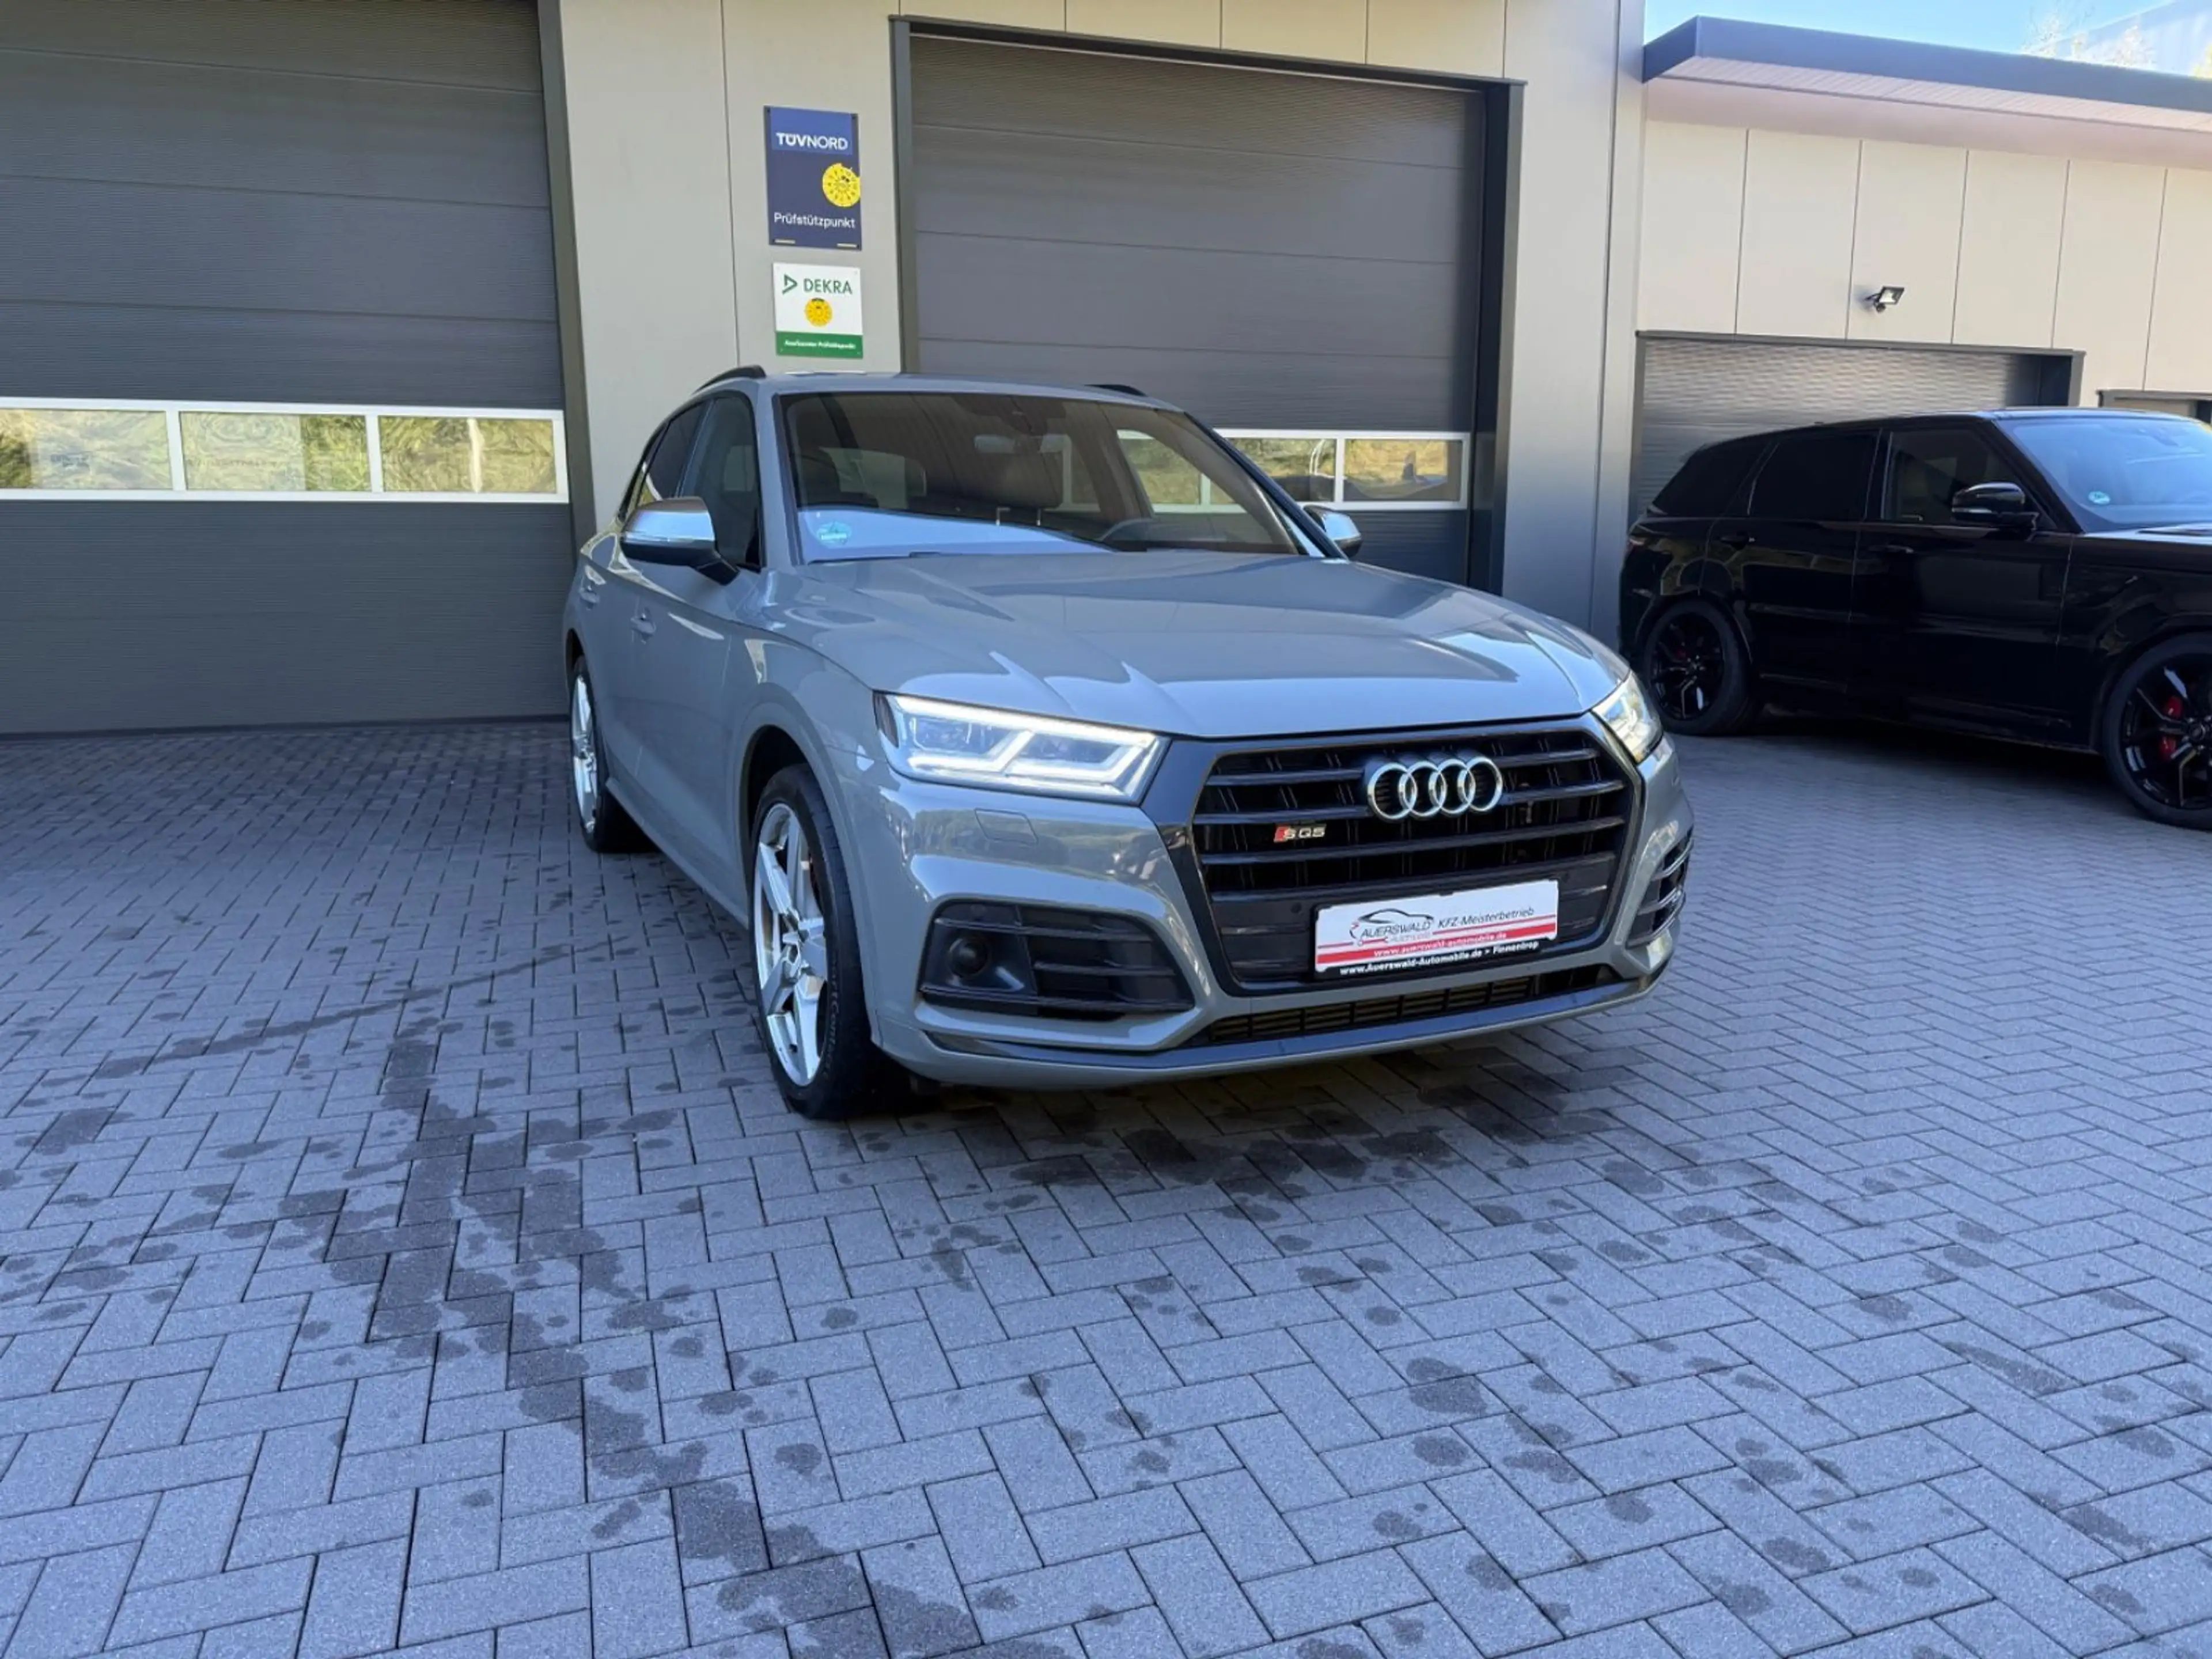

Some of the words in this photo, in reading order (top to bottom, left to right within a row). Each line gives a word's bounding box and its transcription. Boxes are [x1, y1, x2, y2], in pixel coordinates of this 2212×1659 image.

[774, 211, 855, 229] Prüfstützpunkt
[804, 278, 853, 295] DEKRA
[1360, 921, 1431, 938] AUERSWALD
[1438, 907, 1535, 928] KFZ-Meisterbetrieb
